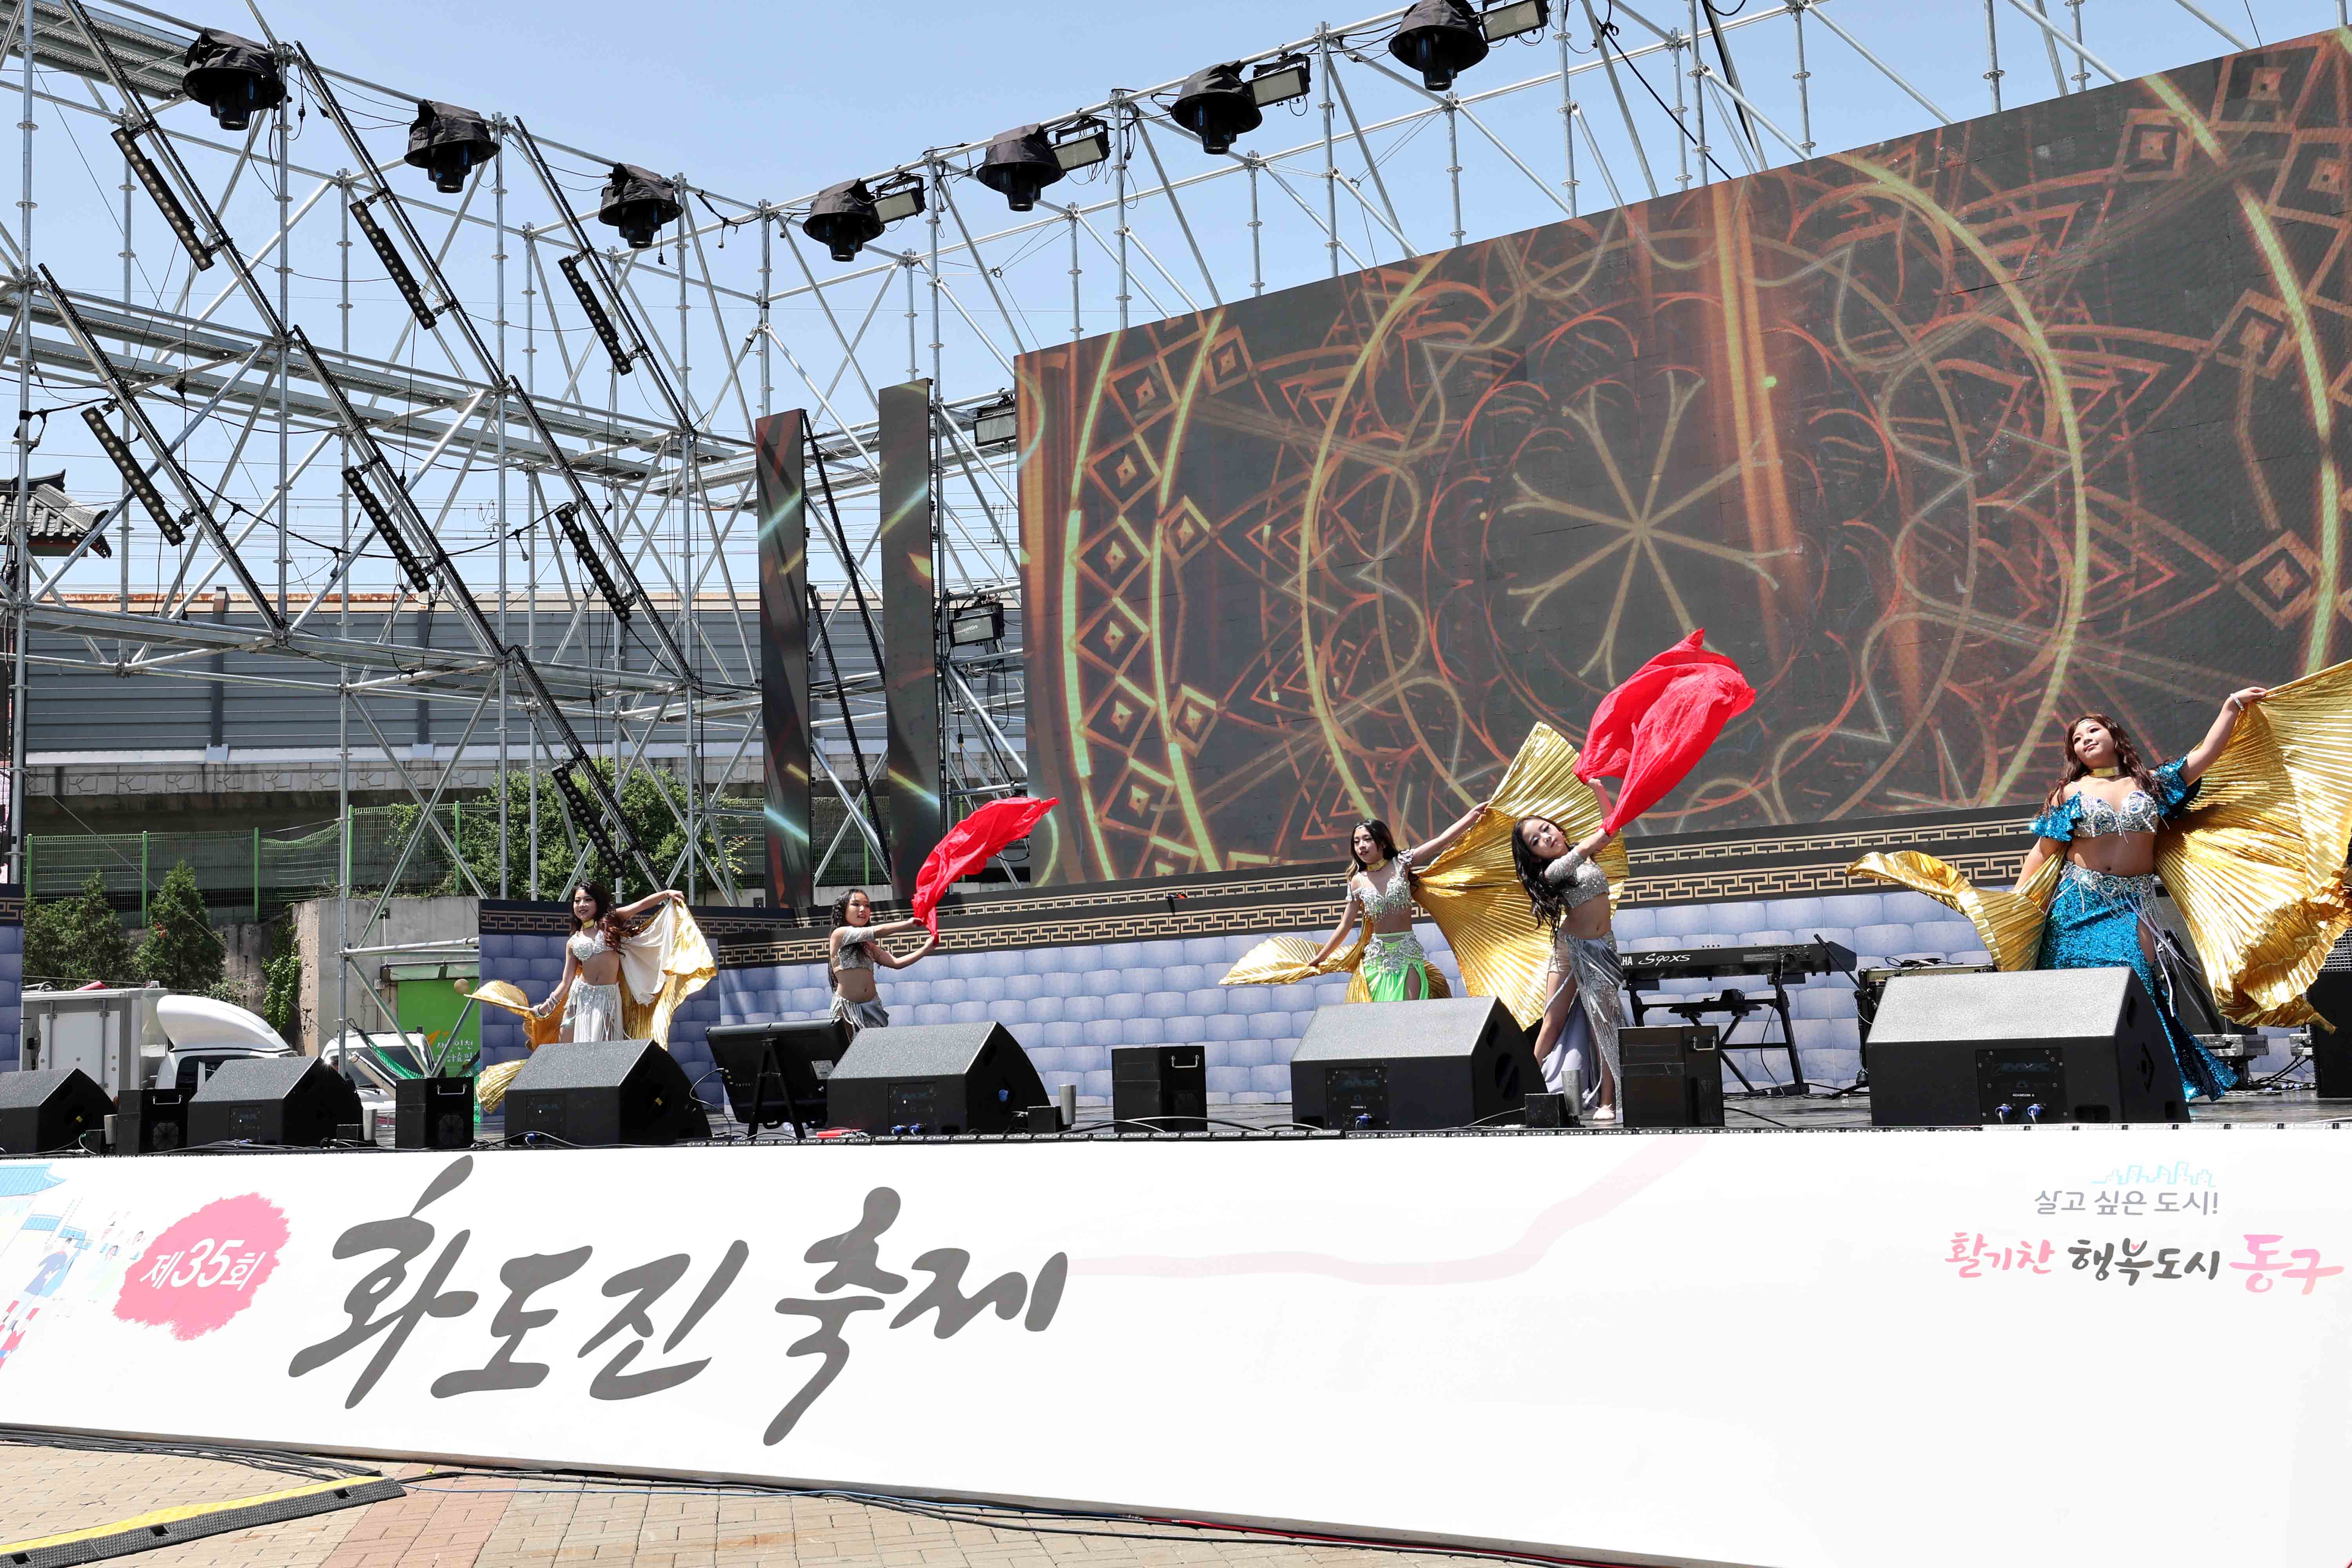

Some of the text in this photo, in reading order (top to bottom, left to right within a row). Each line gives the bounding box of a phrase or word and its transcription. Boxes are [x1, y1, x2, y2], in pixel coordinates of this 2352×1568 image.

[2034, 1190, 2218, 1216] 살고 싶은 도시!
[140, 1238, 267, 1291] 제35회
[1944, 1232, 2056, 1278] 활기찬
[2229, 1233, 2345, 1295] 동구
[288, 1155, 1068, 1446] 화도진 축제
